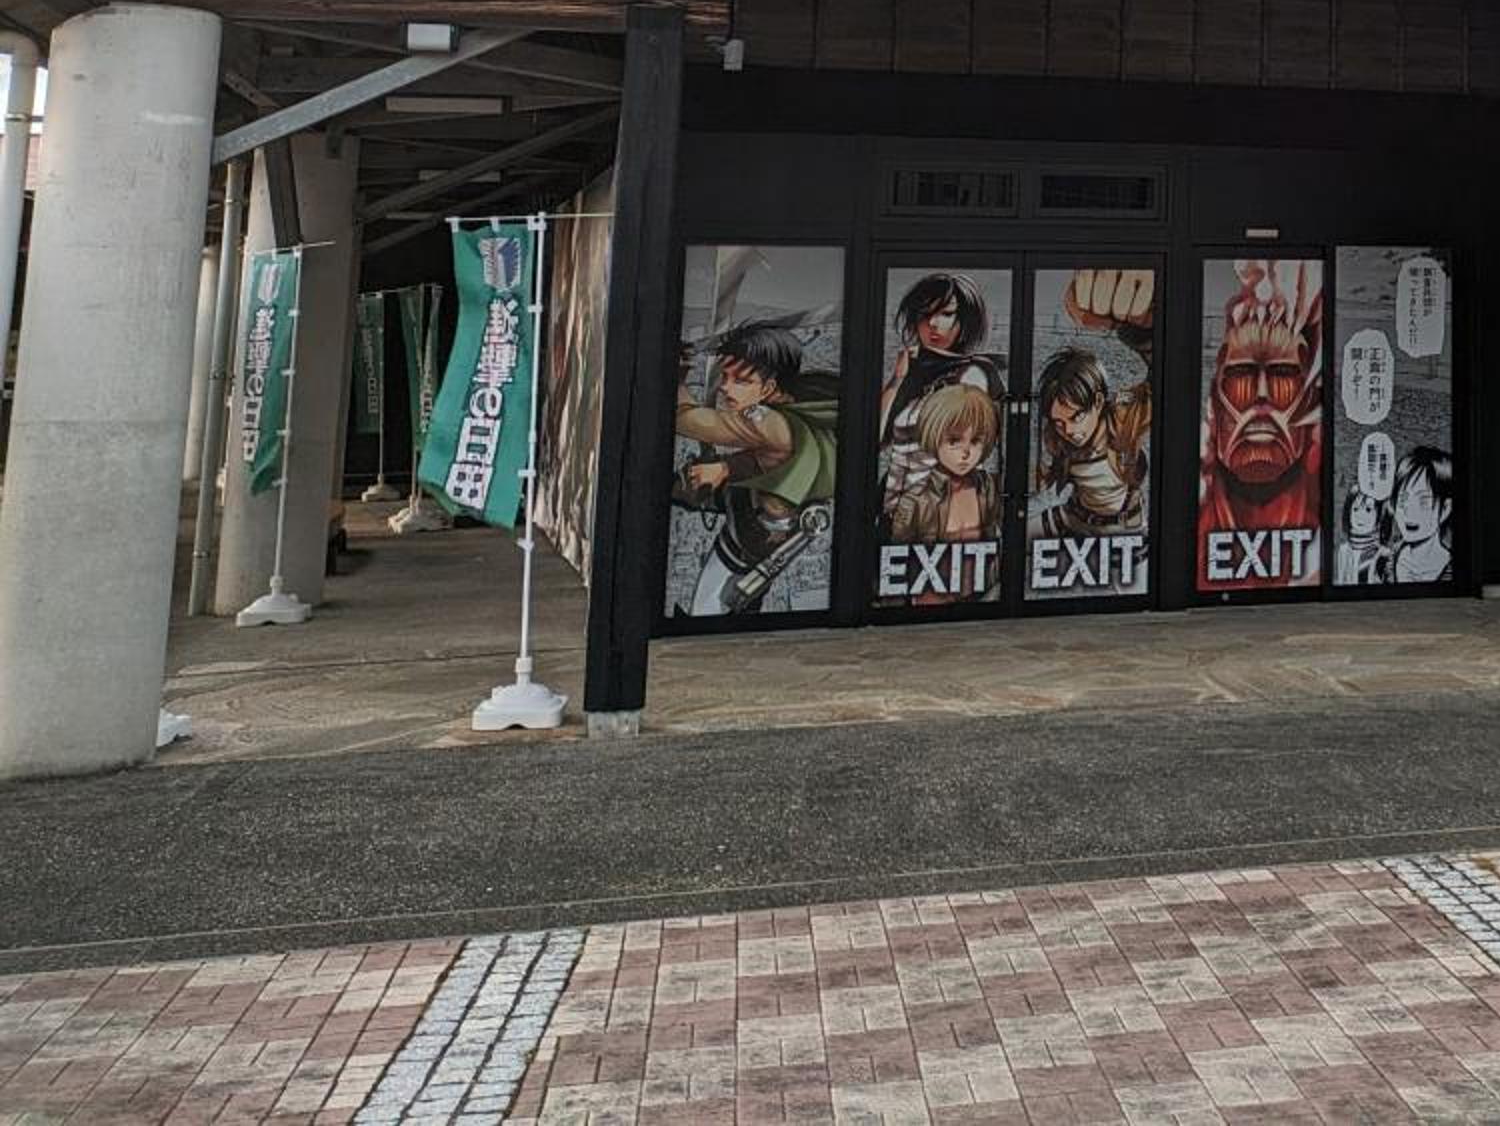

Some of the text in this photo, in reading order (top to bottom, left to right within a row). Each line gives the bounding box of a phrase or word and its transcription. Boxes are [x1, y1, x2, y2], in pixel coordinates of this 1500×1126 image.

[878, 540, 998, 597] EXIT
[1030, 534, 1143, 589] EXIT
[1206, 528, 1315, 581] EXIT
